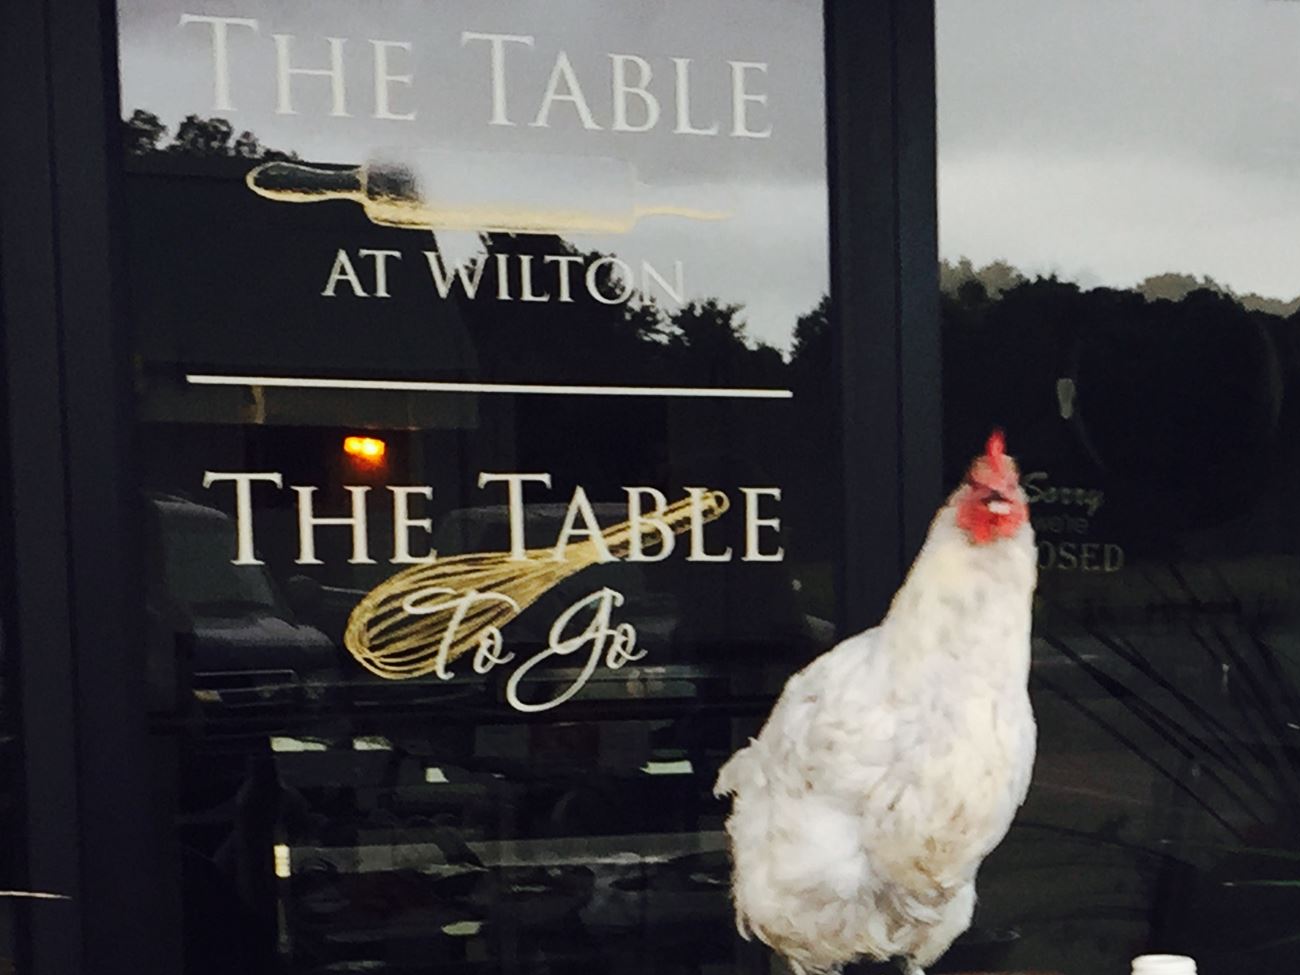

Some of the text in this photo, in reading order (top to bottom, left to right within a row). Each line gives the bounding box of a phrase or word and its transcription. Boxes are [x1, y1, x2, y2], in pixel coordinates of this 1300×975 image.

[179, 13, 772, 139] THE TABLE
[321, 248, 685, 305] AT WILTON
[202, 471, 785, 565] THE TABLE
[1038, 541, 1124, 572] OSED
[403, 585, 648, 712] To Go
